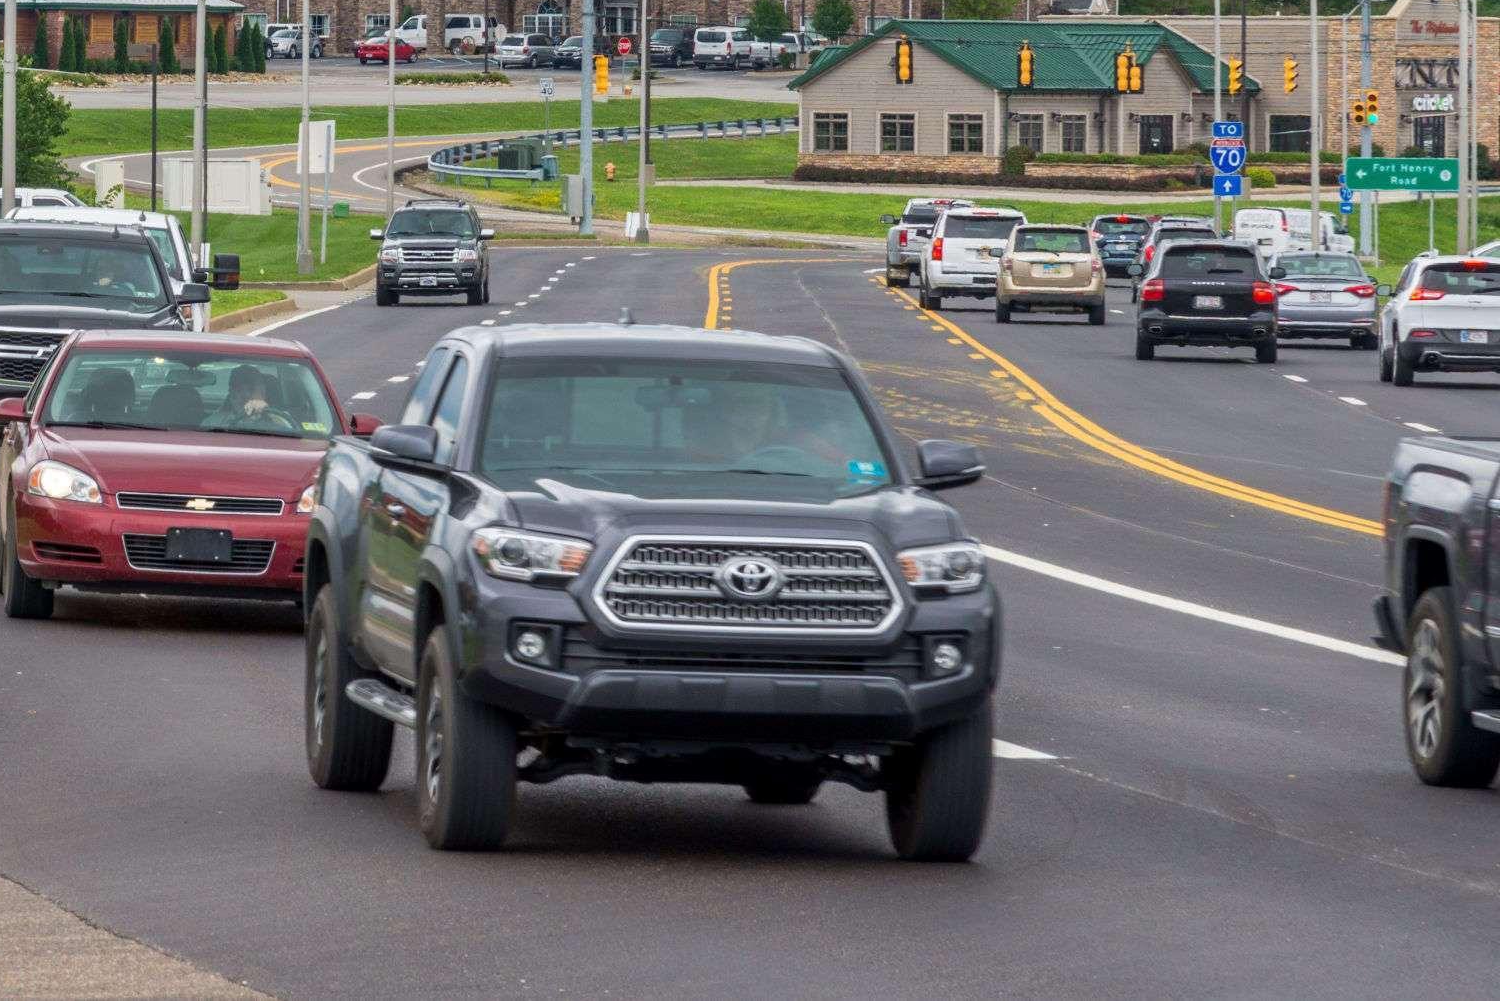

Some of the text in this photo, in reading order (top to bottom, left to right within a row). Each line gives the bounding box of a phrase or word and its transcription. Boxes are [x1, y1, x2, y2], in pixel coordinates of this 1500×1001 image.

[541, 87, 553, 95] 40
[1413, 94, 1454, 111] cricket
[1219, 125, 1237, 135] TO
[1216, 149, 1240, 167] 70
[1373, 164, 1435, 174] Fort Henry
[1390, 177, 1418, 185] Road
